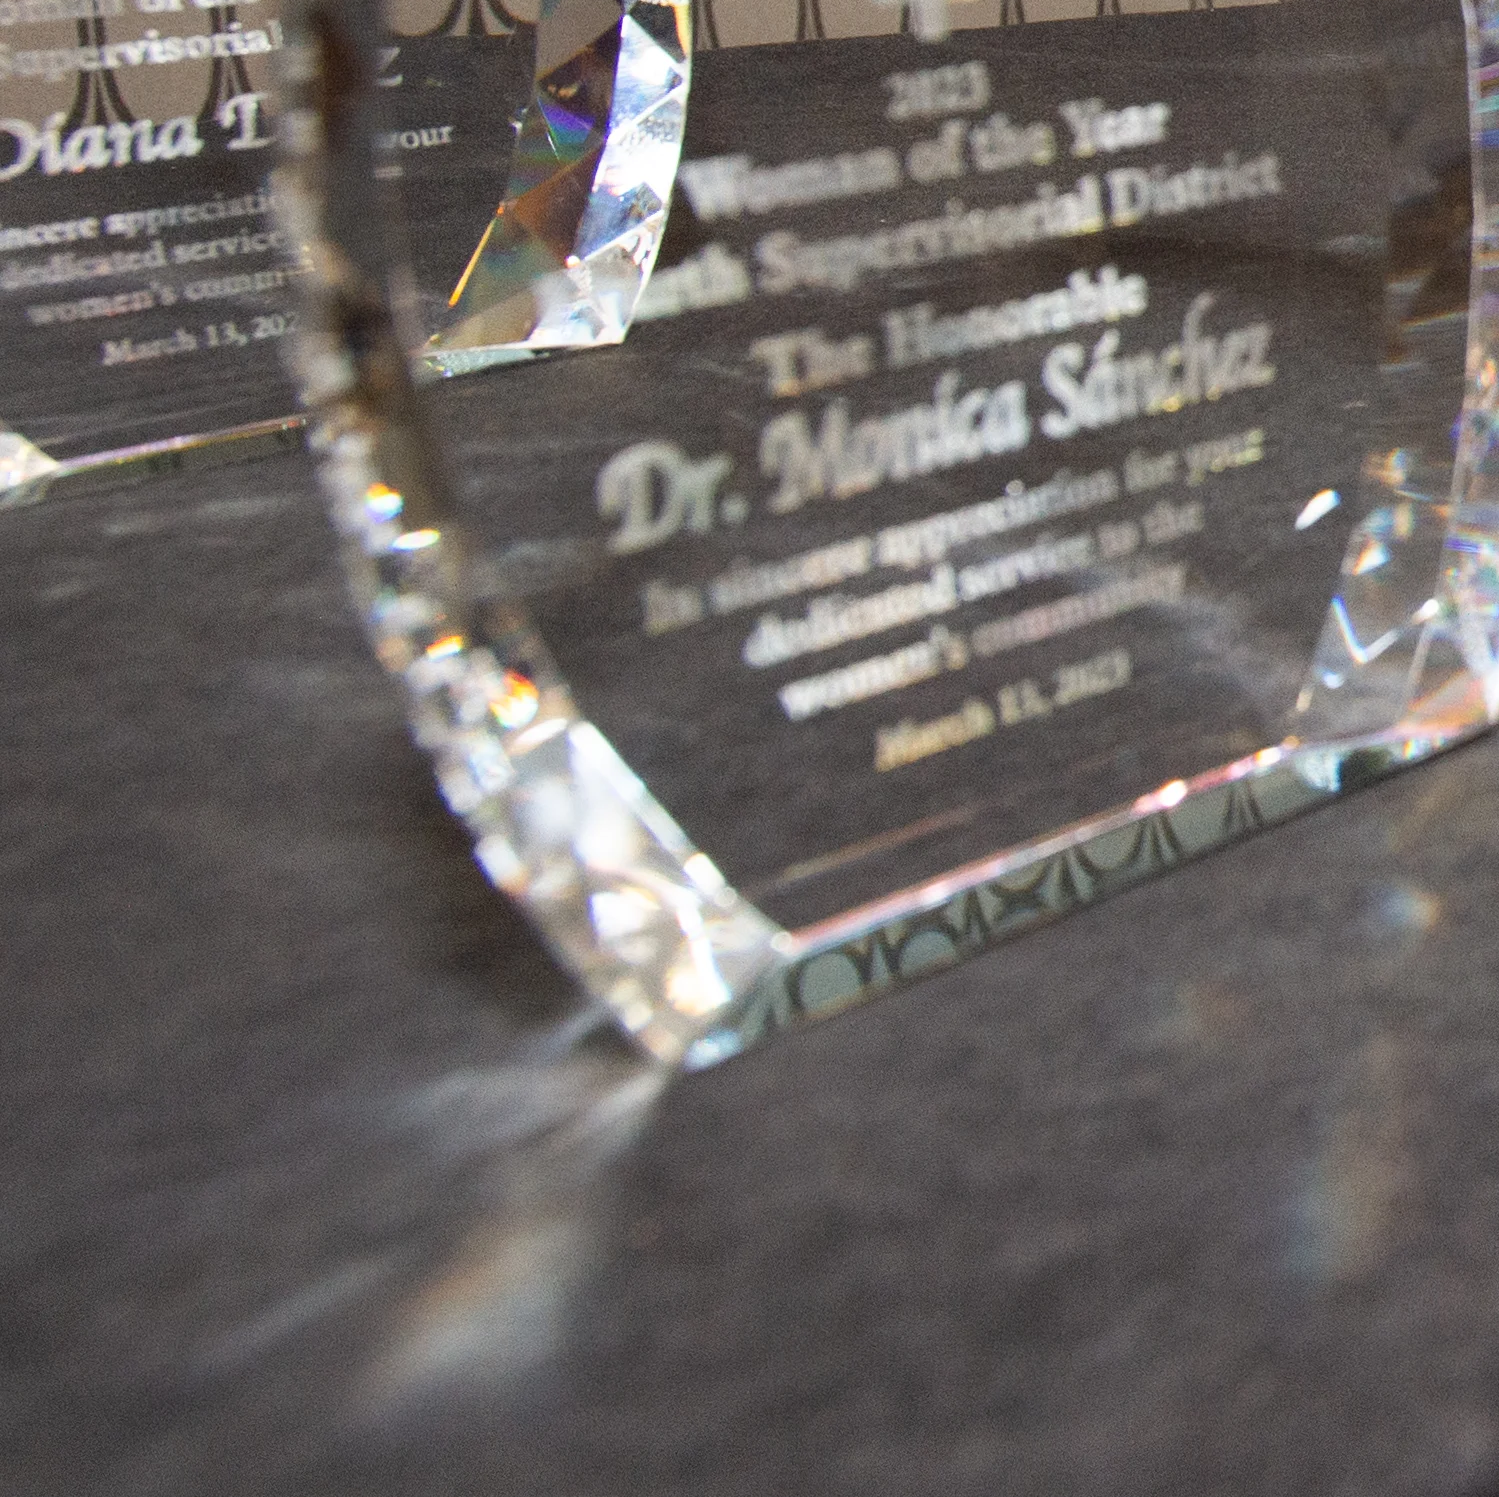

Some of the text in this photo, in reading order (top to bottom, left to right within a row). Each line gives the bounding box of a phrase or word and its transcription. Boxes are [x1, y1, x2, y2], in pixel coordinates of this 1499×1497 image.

[0, 113, 204, 181] Diana
[1060, 98, 1170, 156] Year
[205, 321, 247, 347] 13,
[599, 440, 747, 556] Dr.
